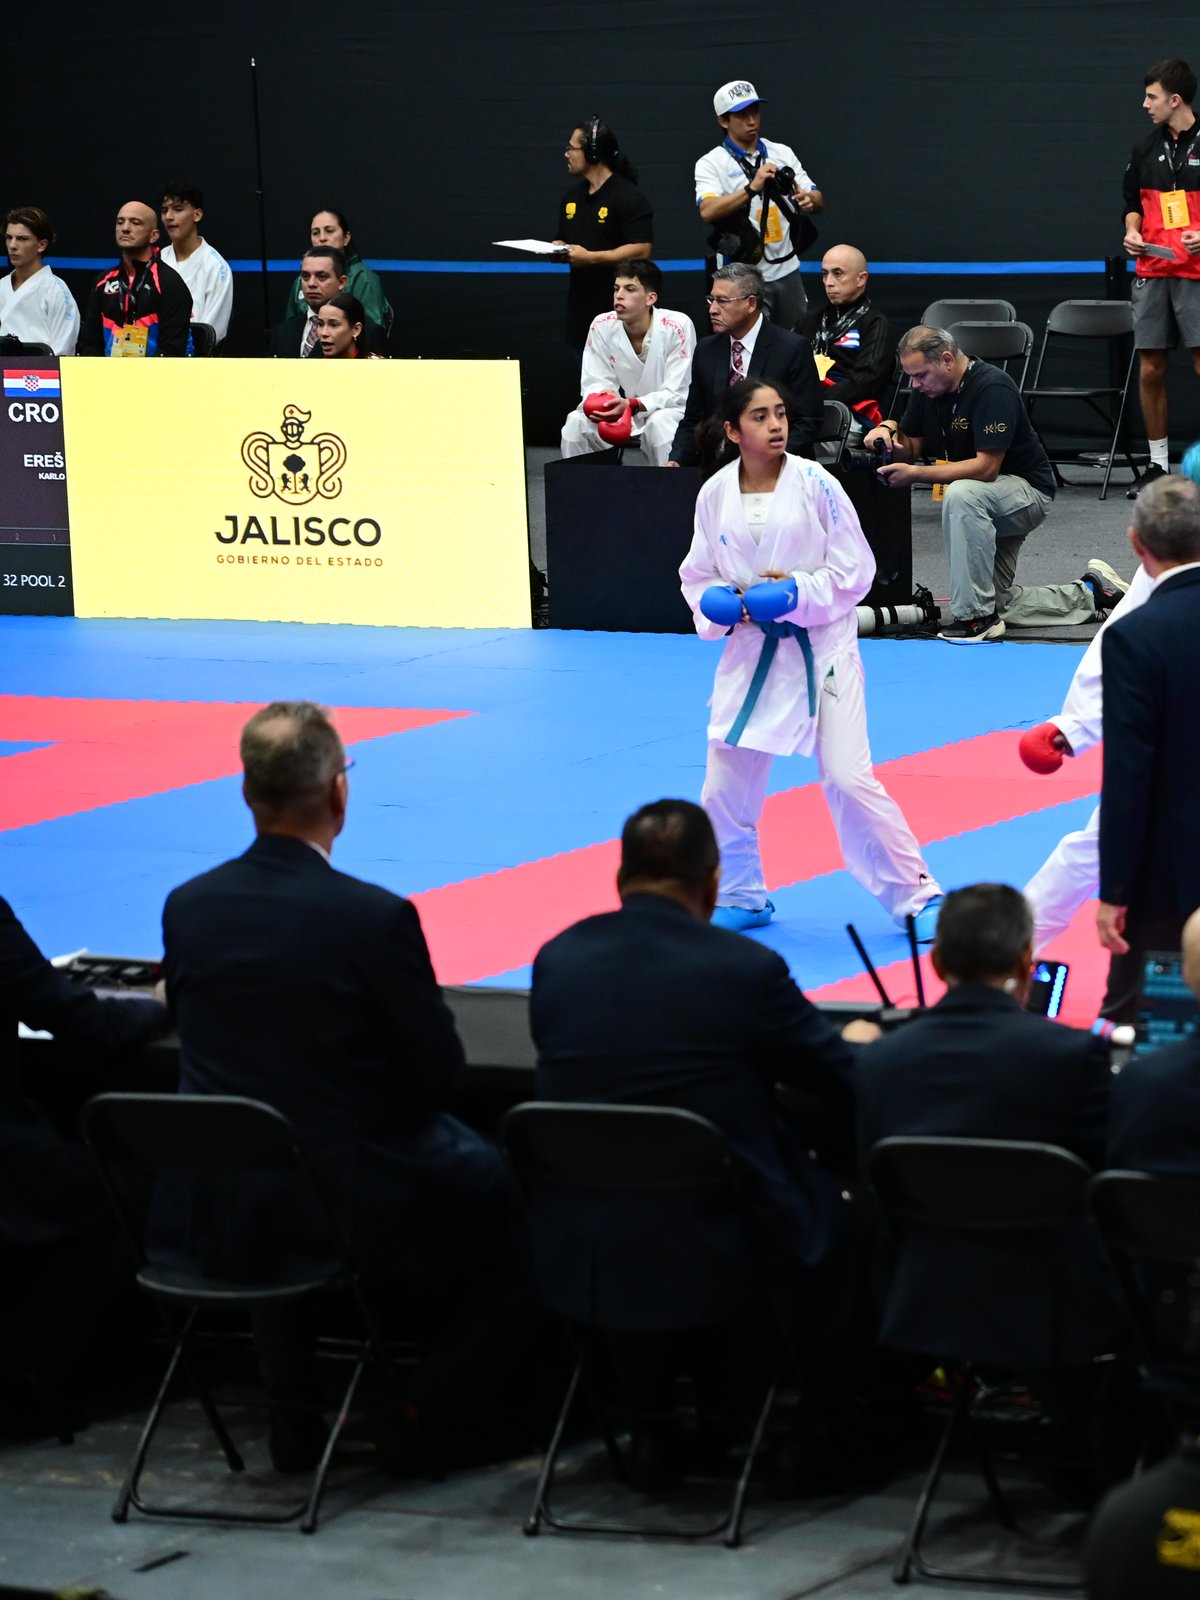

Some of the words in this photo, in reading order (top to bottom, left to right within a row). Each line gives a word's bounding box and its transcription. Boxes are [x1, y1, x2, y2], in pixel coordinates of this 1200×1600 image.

[8, 403, 59, 423] CRO
[24, 452, 64, 468] EREŠ
[39, 472, 66, 480] KARLO
[215, 515, 381, 547] JALISCO
[216, 555, 290, 565] GOBIERNO
[296, 557, 322, 566] DEL
[328, 557, 383, 567] ESTADO
[3, 574, 18, 586] 32
[21, 575, 55, 587] POOL
[58, 576, 66, 587] 2
